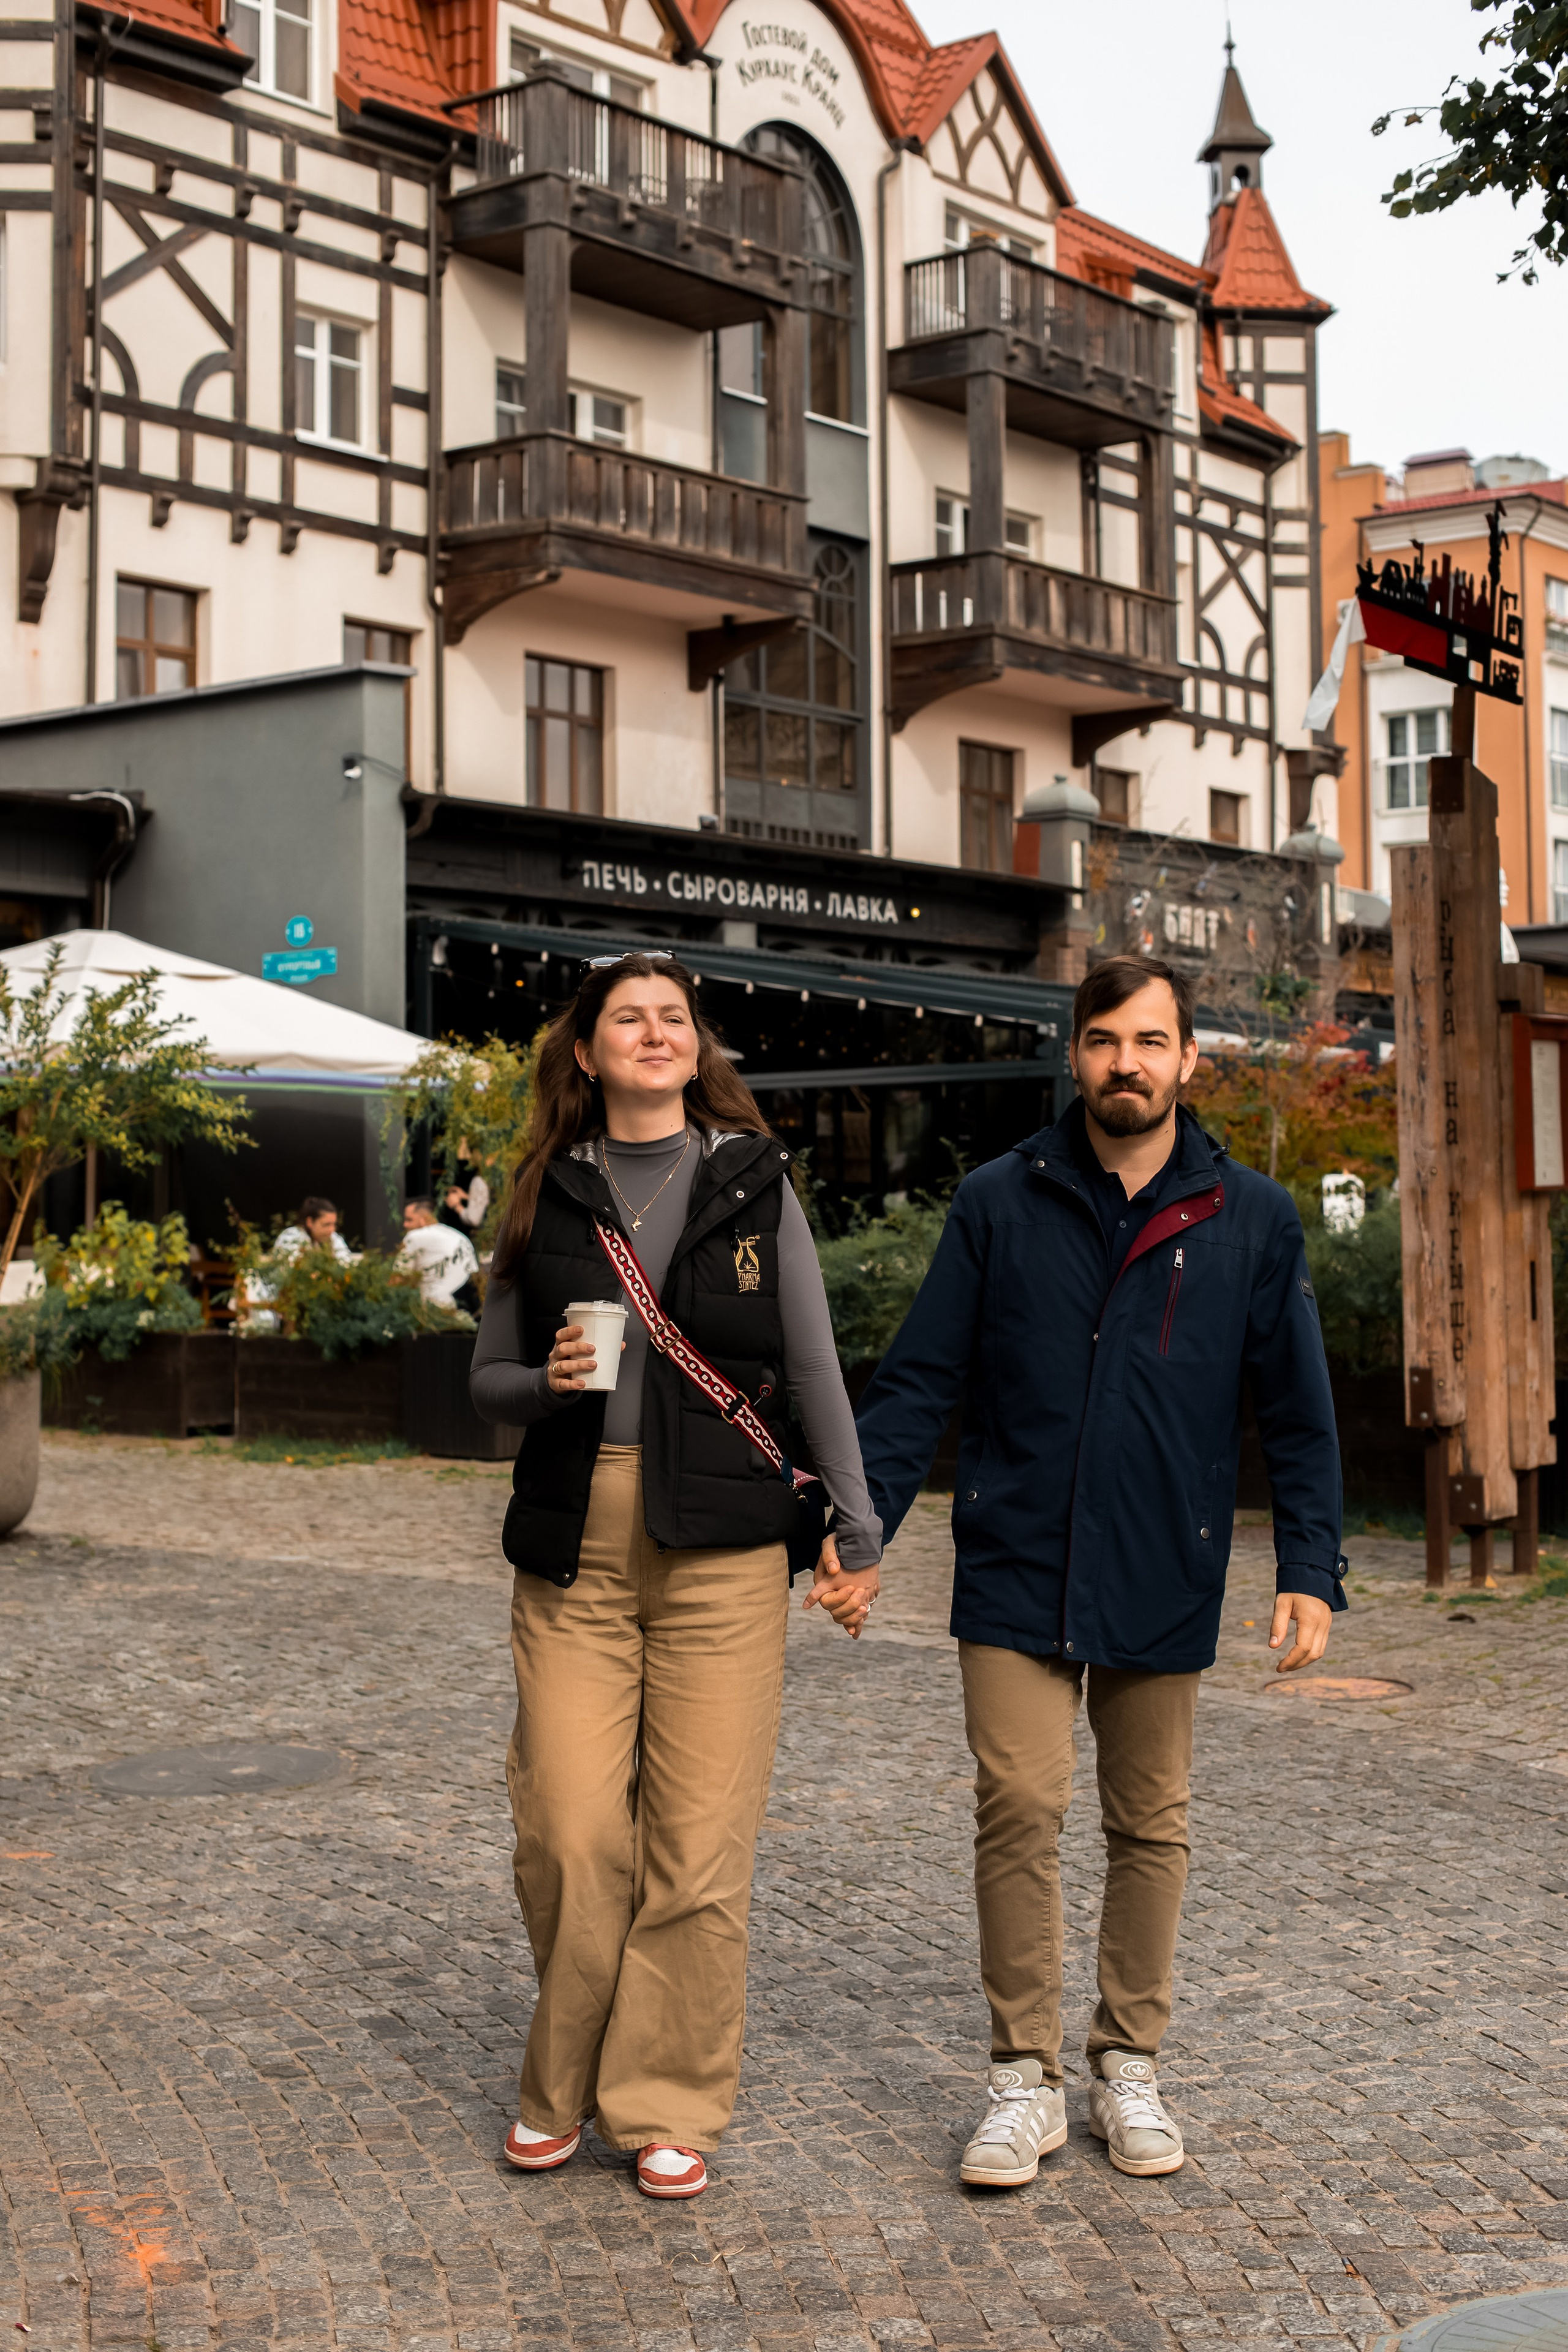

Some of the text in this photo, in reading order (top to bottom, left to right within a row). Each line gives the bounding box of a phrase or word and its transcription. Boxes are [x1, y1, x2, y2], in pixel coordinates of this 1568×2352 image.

[583, 861, 899, 924] ПЕЧЬ СЫРОВАРНЯ ЛАВКА
[738, 1272, 760, 1282] PHARMA
[739, 1280, 759, 1291] SYNTEZ
